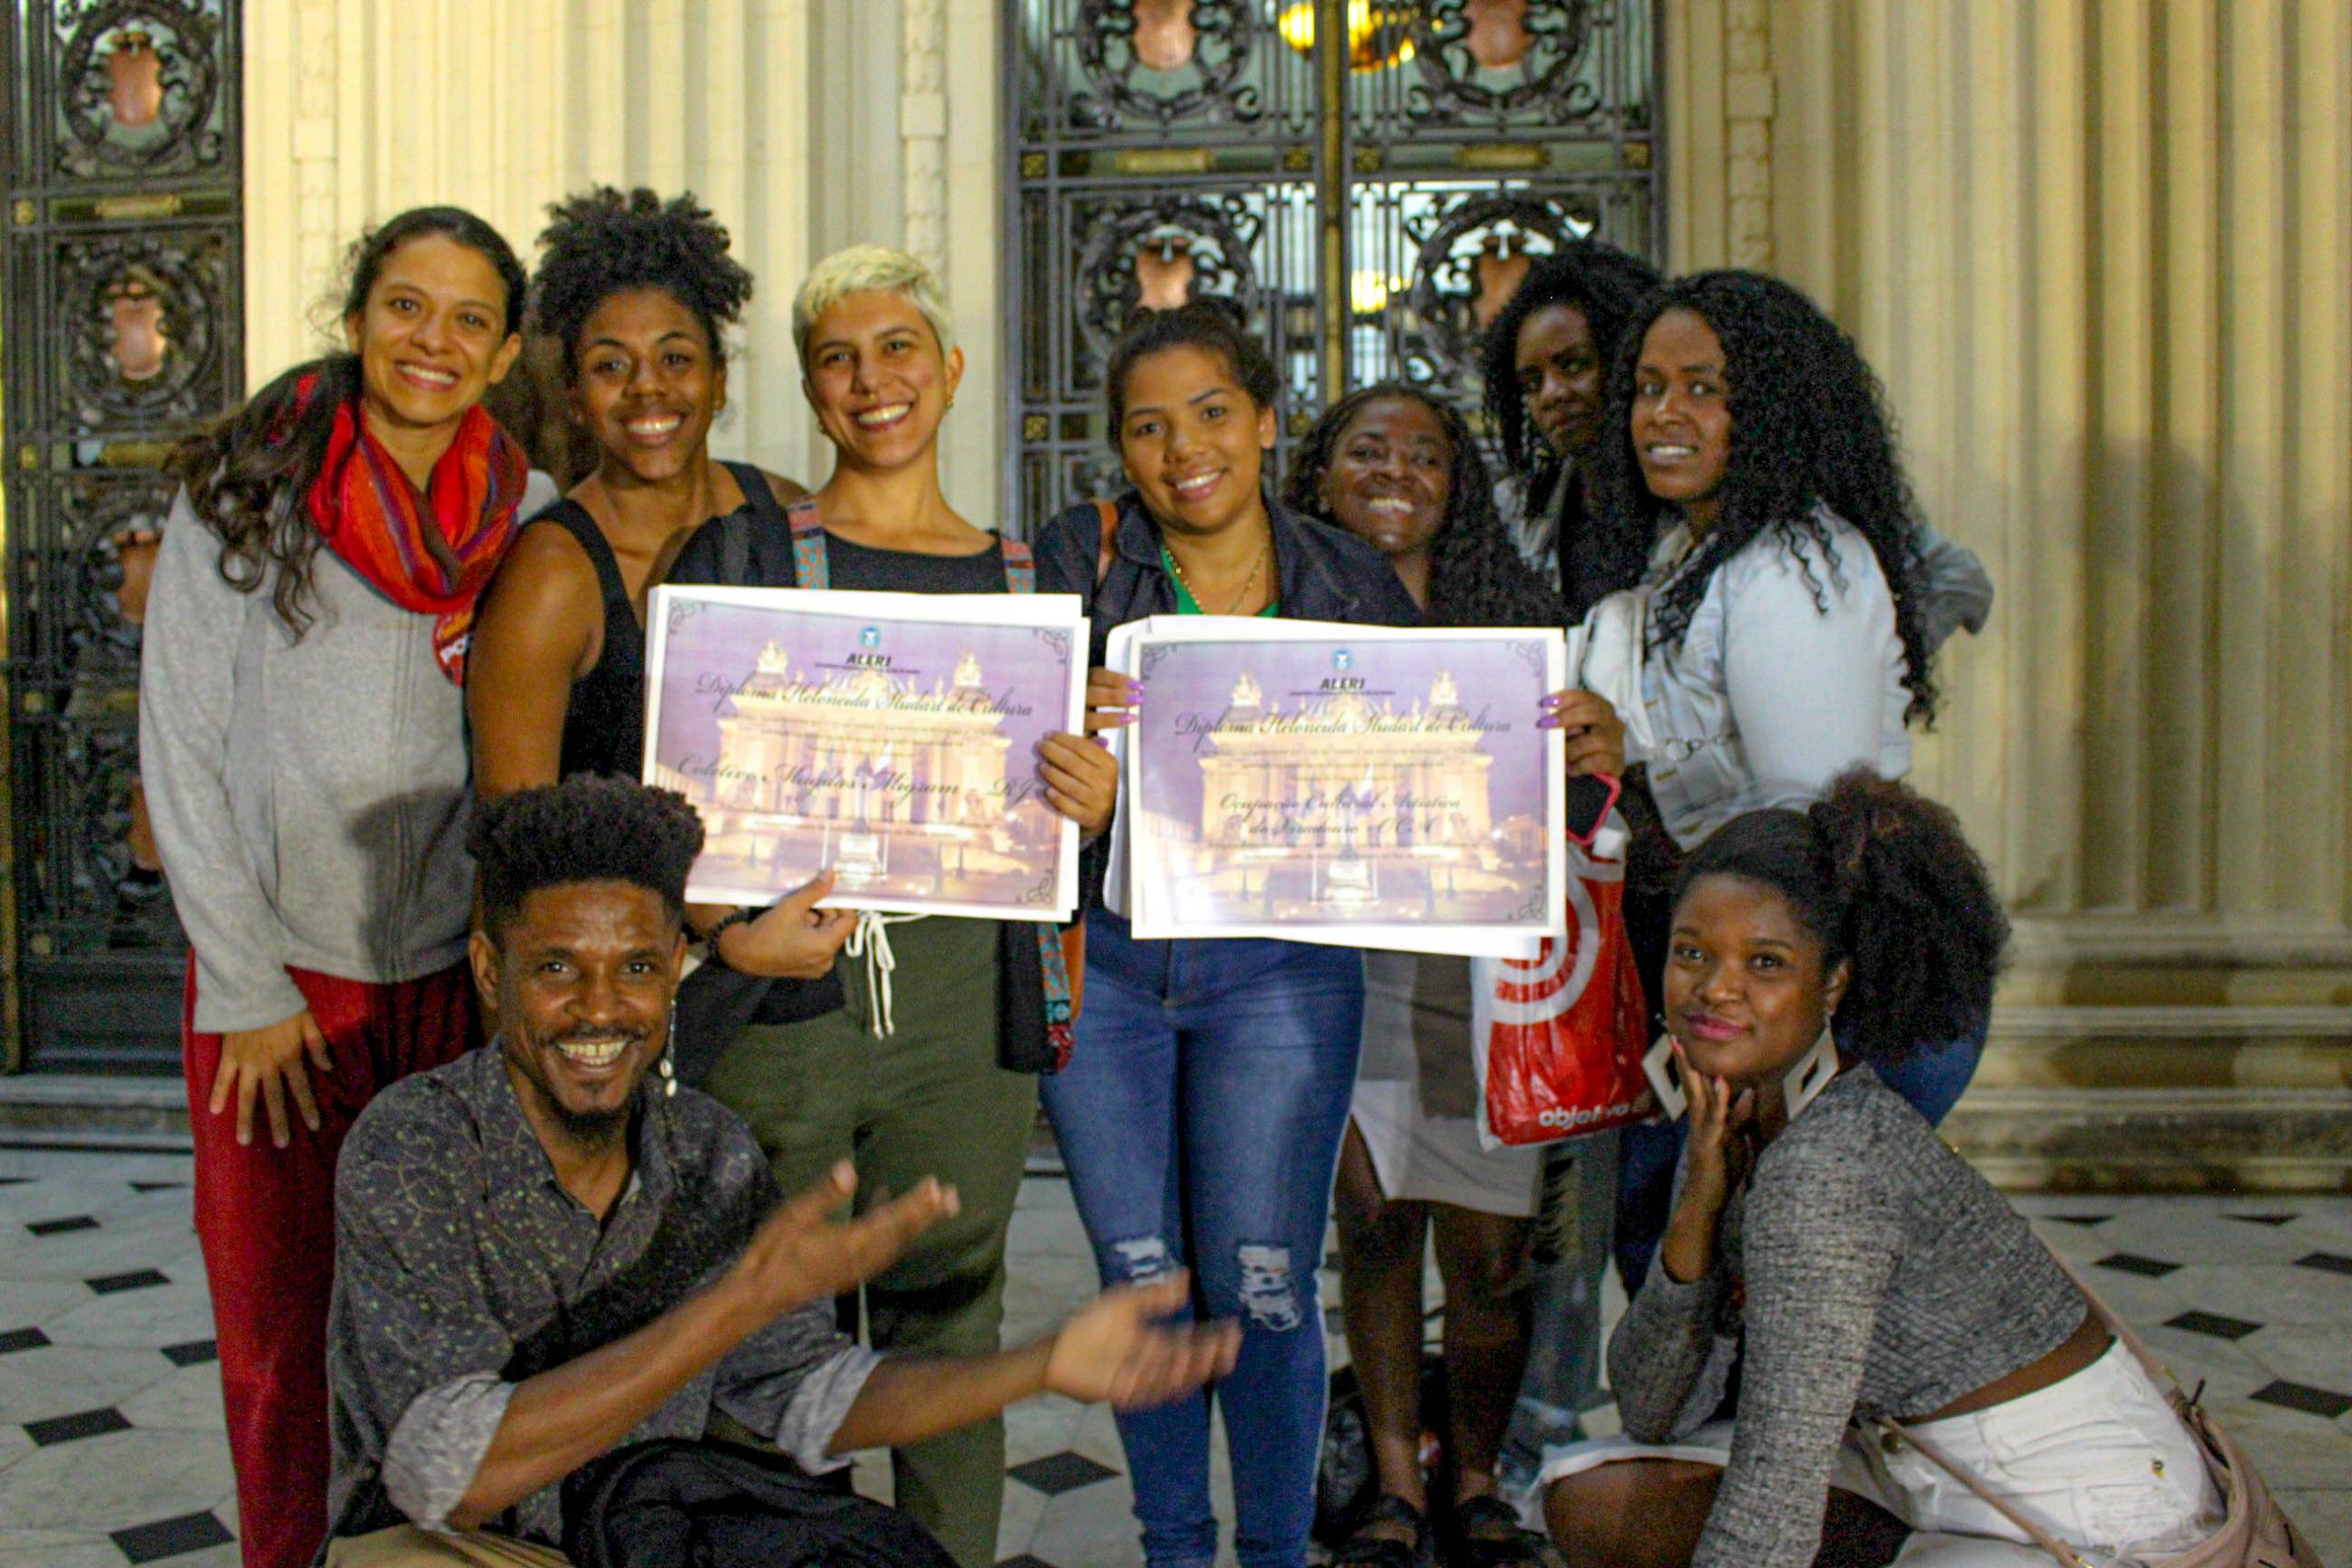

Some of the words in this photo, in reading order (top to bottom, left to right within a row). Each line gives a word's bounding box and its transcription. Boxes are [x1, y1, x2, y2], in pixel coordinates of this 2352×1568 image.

[695, 670, 776, 713] Diploma
[969, 687, 1033, 717] Cultura
[1173, 705, 1254, 753] Diploma
[1448, 704, 1511, 732] Cultura
